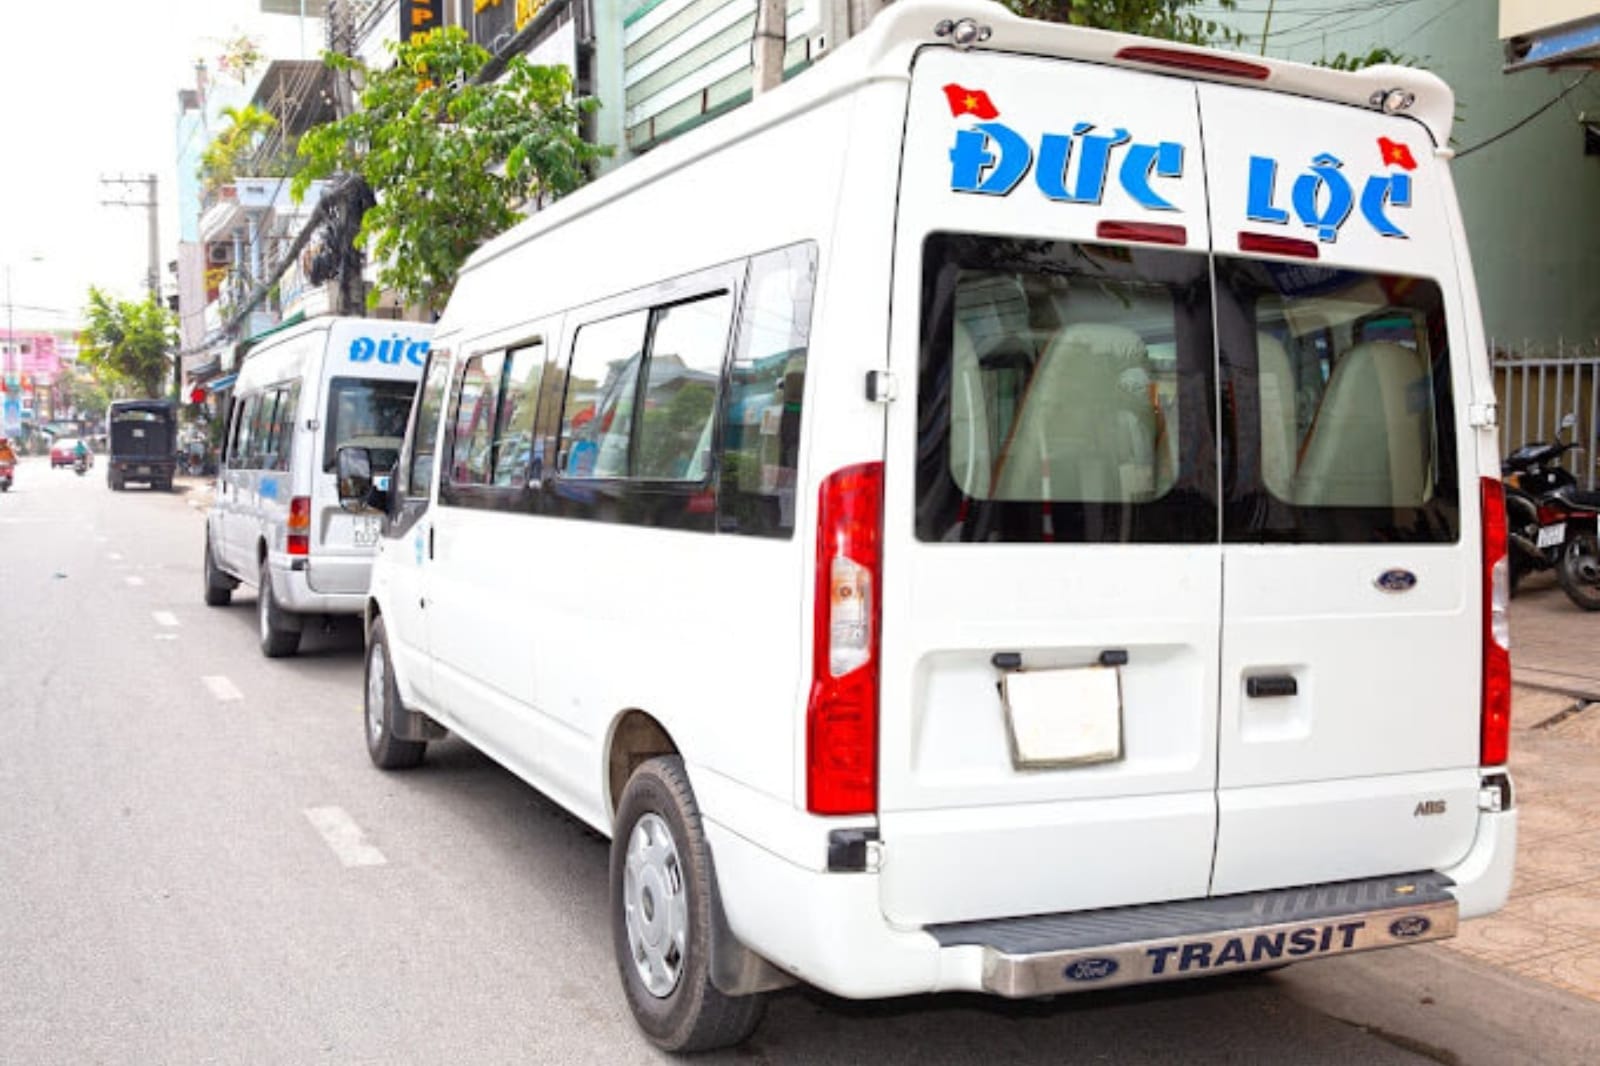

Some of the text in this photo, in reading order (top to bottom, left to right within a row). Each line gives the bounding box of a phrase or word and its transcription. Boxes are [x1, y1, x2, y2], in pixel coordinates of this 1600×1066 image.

[948, 121, 1412, 243] ĐỨC LỘC
[1145, 920, 1366, 975] TRANSIT
